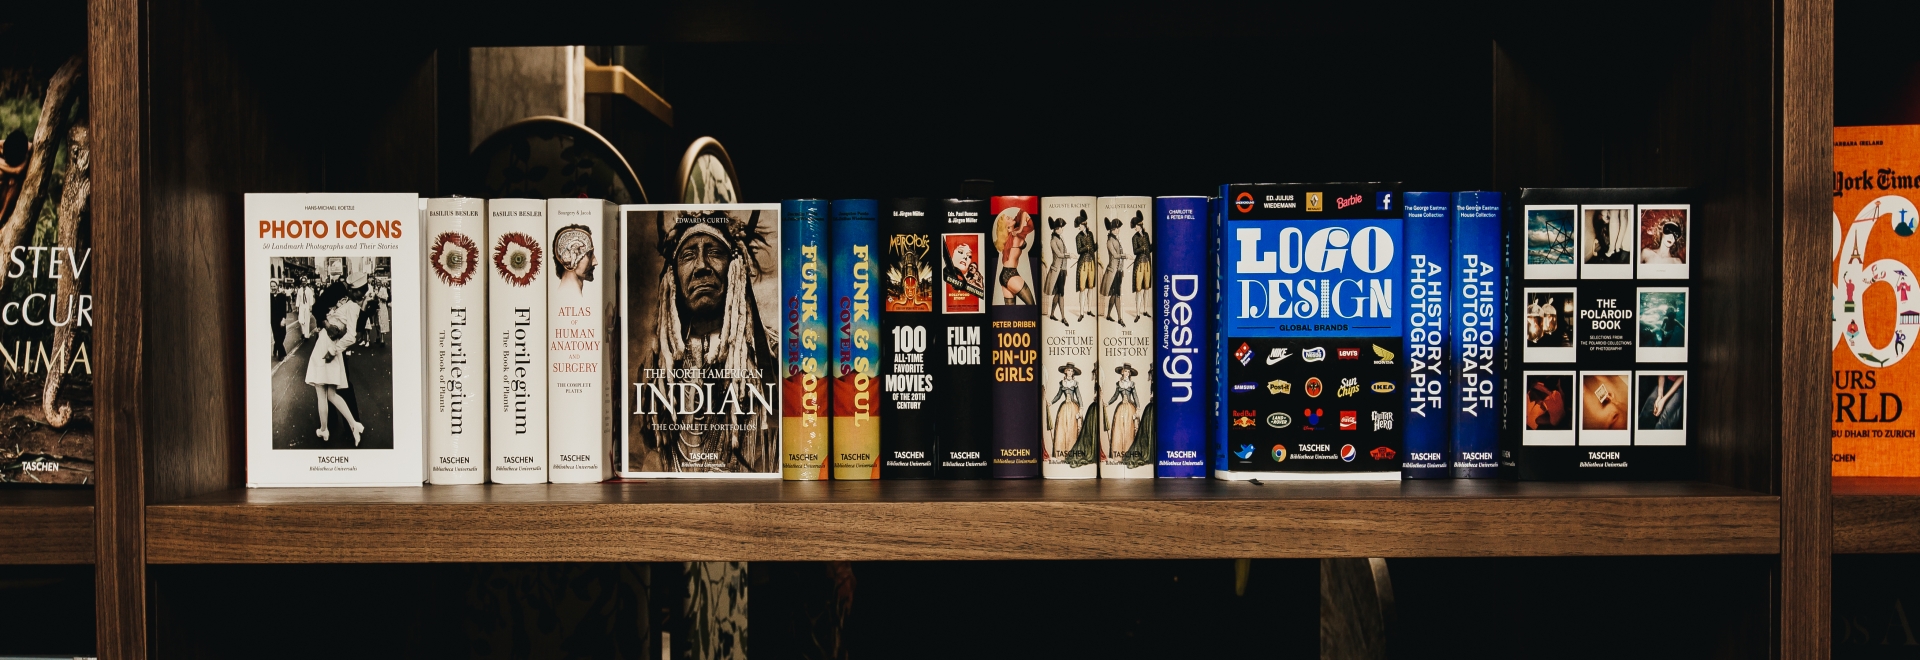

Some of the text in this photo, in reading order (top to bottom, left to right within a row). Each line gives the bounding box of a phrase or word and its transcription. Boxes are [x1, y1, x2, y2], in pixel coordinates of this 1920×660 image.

[1336, 194, 1363, 210] Barbie
[1383, 194, 1390, 210] f
[260, 220, 402, 239] PHOTO ICONS
[306, 242, 344, 251] Photographs
[1236, 226, 1394, 274] LOGO
[8, 246, 90, 279] STEV
[1164, 275, 1170, 284] of
[1236, 279, 1392, 319] DESIGN
[1596, 299, 1617, 308] THE
[558, 307, 591, 317] ATLAS
[1580, 310, 1633, 319] POLAROID
[1592, 320, 1621, 330] BOOK
[554, 328, 594, 338] HUMAN
[788, 296, 800, 376] COVERS
[802, 244, 818, 428] FUNK & SOUL
[840, 296, 851, 376] COVERS
[853, 244, 870, 428] FUNK & SOUL
[892, 325, 927, 353] 100
[947, 326, 980, 345] FILM
[997, 332, 1030, 348] 1000
[1162, 274, 1198, 403] Design
[1411, 254, 1426, 417] PHOTOGRAPHY
[1428, 262, 1442, 409] A HISTORY OF
[1462, 254, 1478, 417] PHOTOGRAPHY
[1480, 262, 1494, 409] A HISTORY OF
[550, 341, 600, 351] ANATOMY
[1047, 337, 1094, 346] COSTUME
[1103, 337, 1150, 346] COSTUME
[894, 354, 924, 363] ALL-TIME
[947, 346, 981, 365] NOIR
[992, 350, 1037, 365] PIN-UP
[1049, 347, 1092, 356] HISTORY
[1105, 348, 1148, 356] HISTORY
[1271, 348, 1288, 357] NIKE
[446, 306, 467, 436] Florilegium
[511, 306, 531, 435] Florilegium
[552, 363, 598, 373] SURGERY
[644, 368, 763, 379] THE NORTH AMERICAN
[894, 364, 924, 373] FAVORITE
[995, 367, 1034, 382] GIRLS
[439, 374, 446, 384] of
[886, 374, 933, 392] MOVIES
[1340, 377, 1358, 388] Sun
[1832, 370, 1876, 390] URS
[1337, 384, 1360, 398] Chips
[632, 382, 776, 416] INDIAN
[897, 402, 921, 410] CENTURY
[1832, 392, 1903, 423] RLD
[318, 456, 349, 464] TASCHEN
[1588, 452, 1620, 460] TASCHEN
[22, 461, 59, 472] TASCHEN
